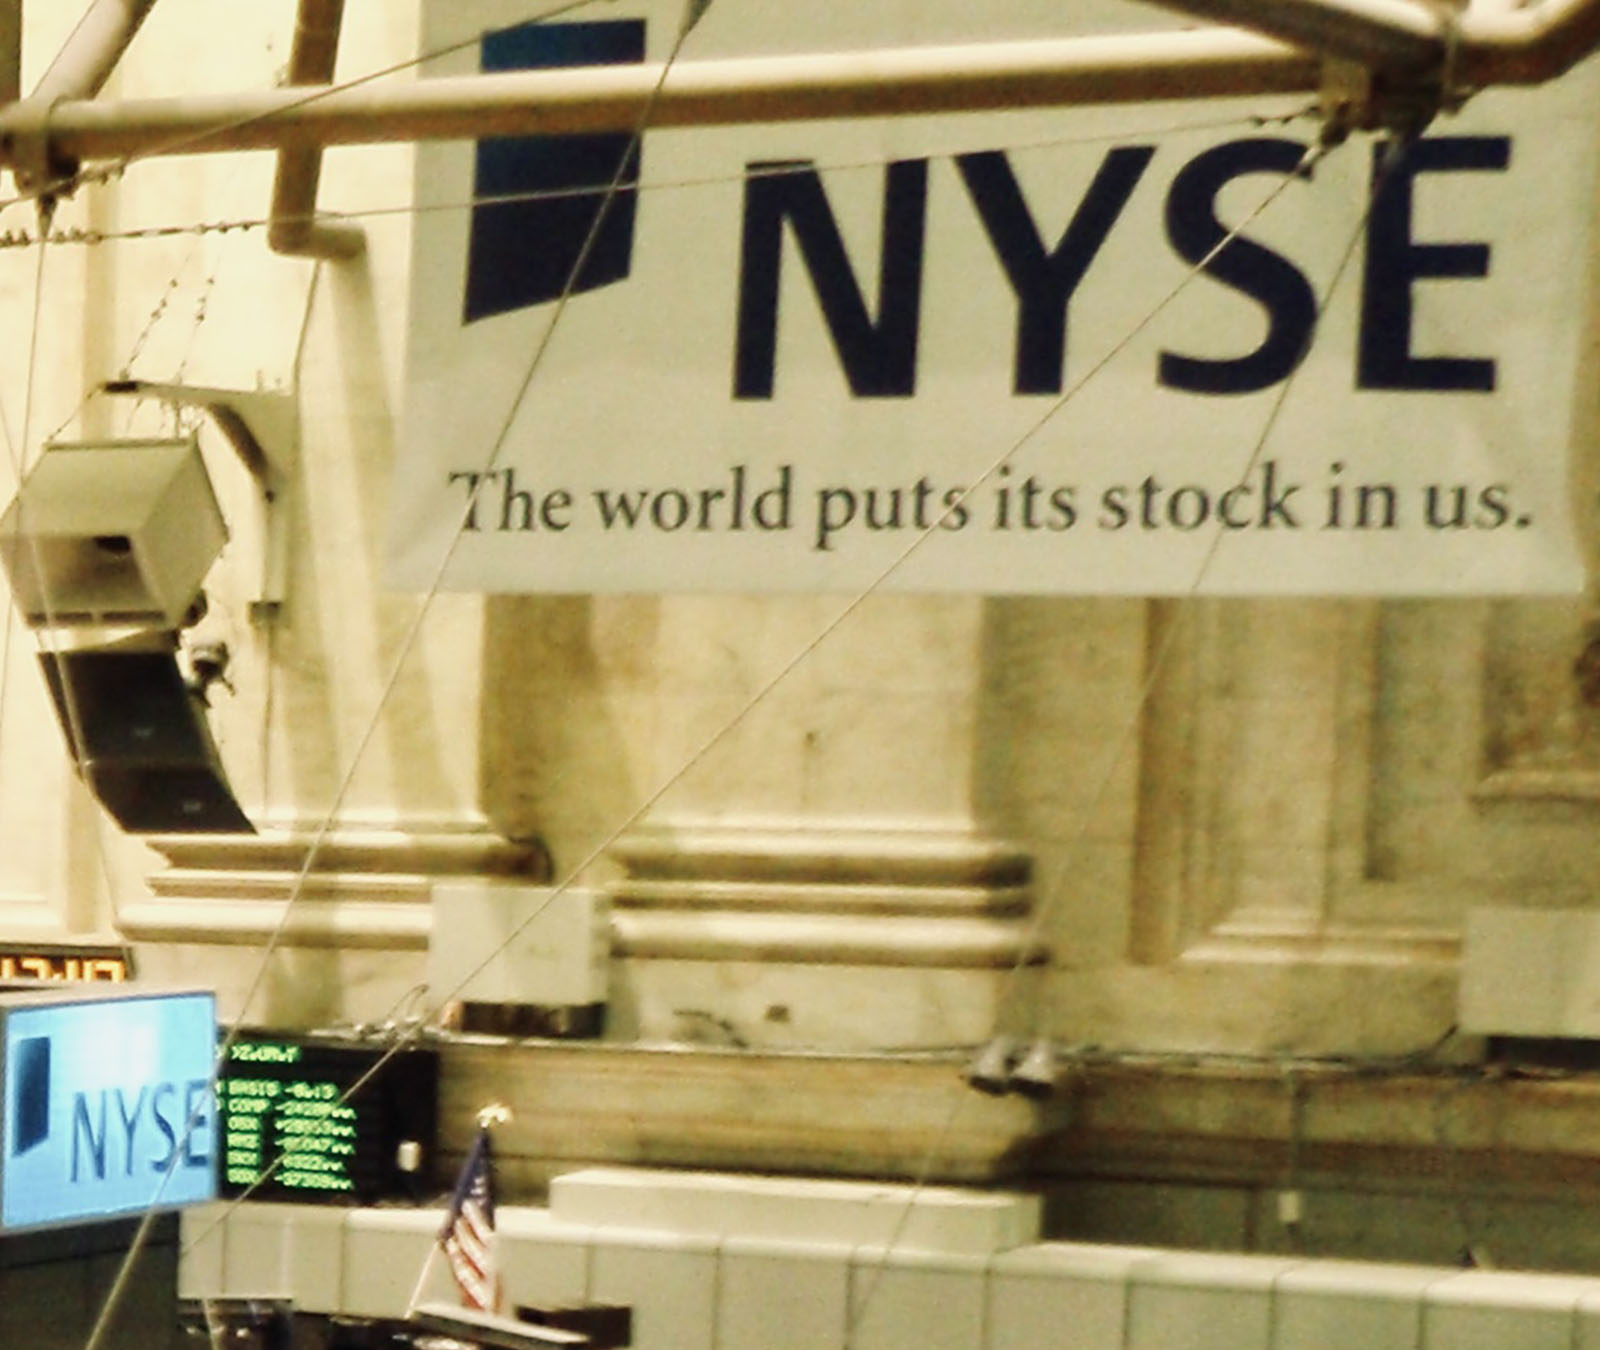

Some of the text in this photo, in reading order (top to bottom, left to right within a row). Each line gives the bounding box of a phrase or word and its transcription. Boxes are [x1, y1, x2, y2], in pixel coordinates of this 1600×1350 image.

[731, 135, 1513, 400] NYSE
[448, 461, 1534, 551] The world puts its stock in us.
[69, 1079, 212, 1183] NYSE
